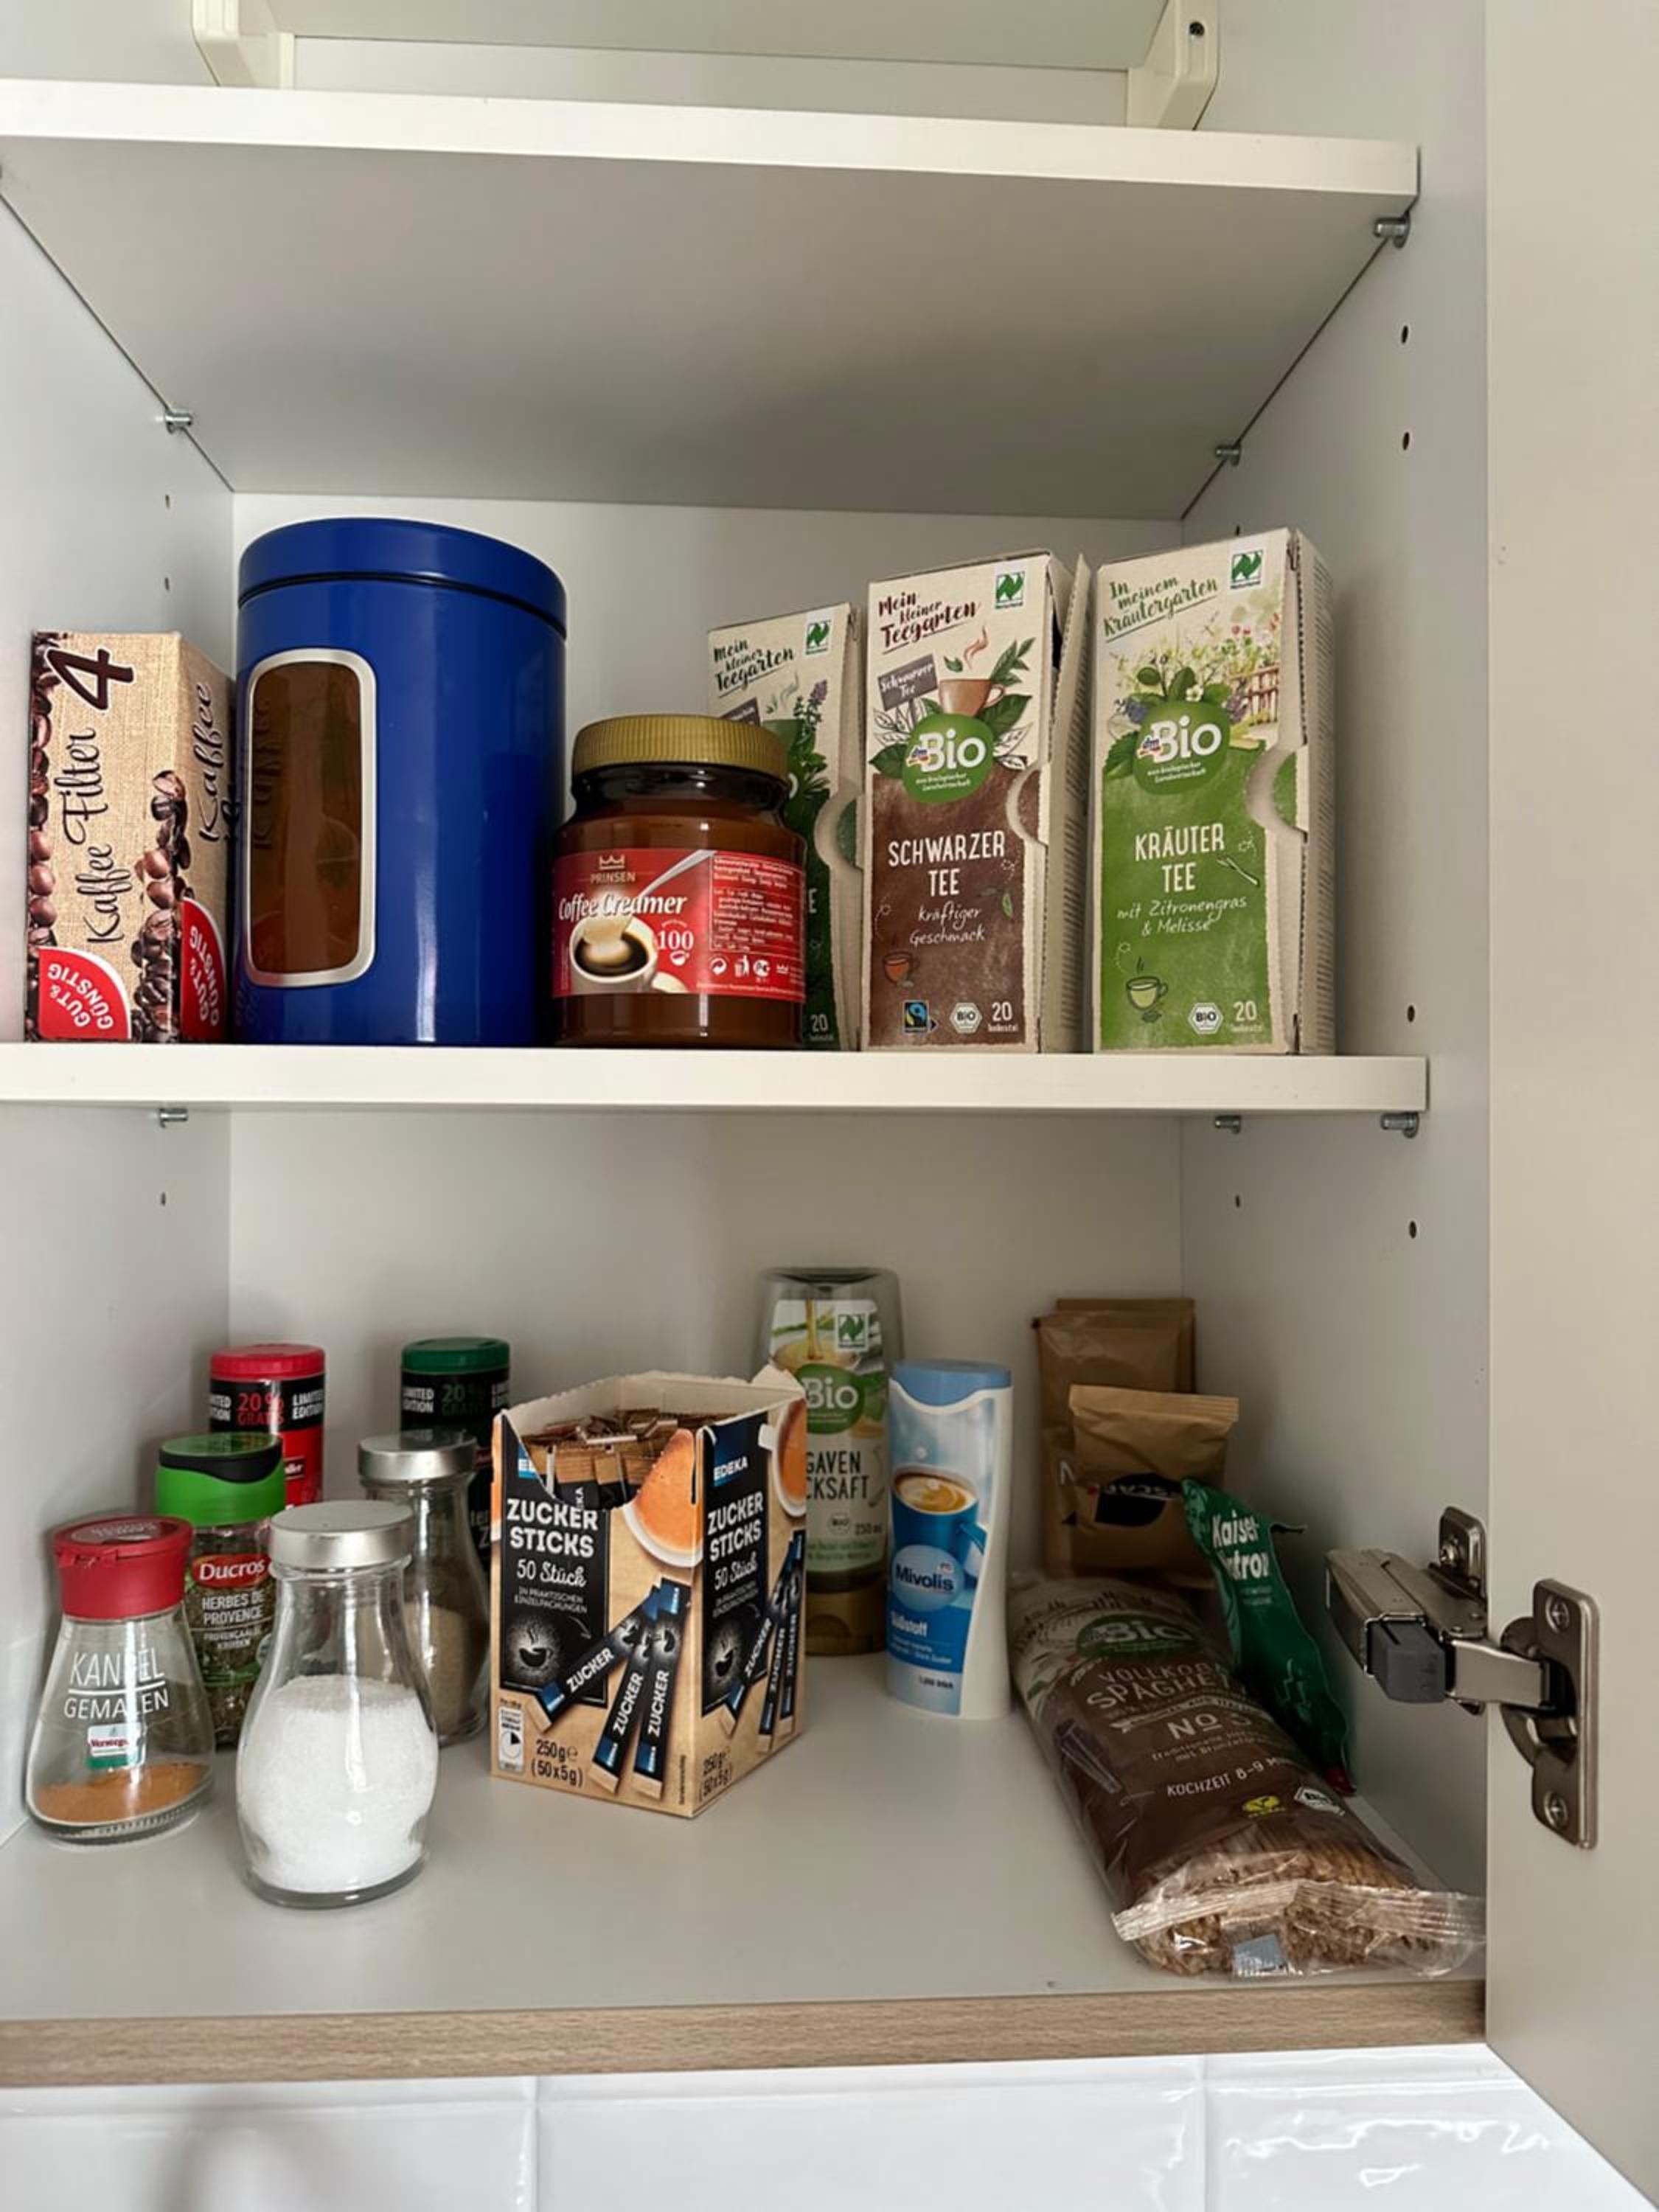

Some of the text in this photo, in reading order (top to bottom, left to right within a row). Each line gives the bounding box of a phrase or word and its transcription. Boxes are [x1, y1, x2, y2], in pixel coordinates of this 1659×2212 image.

[877, 592, 917, 617] Mein
[1109, 579, 1130, 601] In
[1118, 575, 1179, 611] meinem
[1103, 578, 1219, 638] Kräutergarten
[880, 602, 976, 648] Teegarten
[713, 639, 748, 664] Mein
[47, 648, 135, 711] 4
[714, 647, 795, 692] Teegarten
[919, 728, 987, 773] Bio
[1150, 715, 1223, 764] Bio
[54, 727, 135, 942] Kaffee Filter
[888, 830, 1006, 867] SCHWARZER
[1135, 822, 1225, 861] KRÄUTER
[590, 870, 636, 884] PRINSEN
[928, 868, 960, 897] TEE
[1161, 862, 1197, 893] TEE
[558, 891, 688, 922] Coffee Creamer
[1149, 896, 1248, 923] Zitronengras
[656, 931, 695, 952] 100
[47, 963, 114, 1029] GÜNSTIG
[991, 1001, 1013, 1022] 20
[1232, 1000, 1257, 1022] 20
[810, 1014, 828, 1032] 20
[713, 1455, 748, 1481] EDEKA
[805, 1450, 861, 1475] GAVEN
[507, 1498, 599, 1531] ZUCKER
[708, 1491, 765, 1536] ZUCKER
[509, 1526, 594, 1558] STICKS
[709, 1519, 762, 1562] STICKS
[199, 1558, 266, 1581] Ducros
[517, 1558, 588, 1587] 50 Stück
[714, 1566, 728, 1591] 50
[895, 1563, 955, 1592] Mivolis
[201, 1592, 249, 1610] HERBES
[203, 1604, 265, 1626] PROVENCE
[70, 1647, 165, 1687] KANEL
[566, 1646, 615, 1693] ZUCKER
[613, 1672, 644, 1736] ZUCKER
[647, 1669, 670, 1737] ZUCKER
[1166, 1773, 1232, 1797] KOCHZEIT
